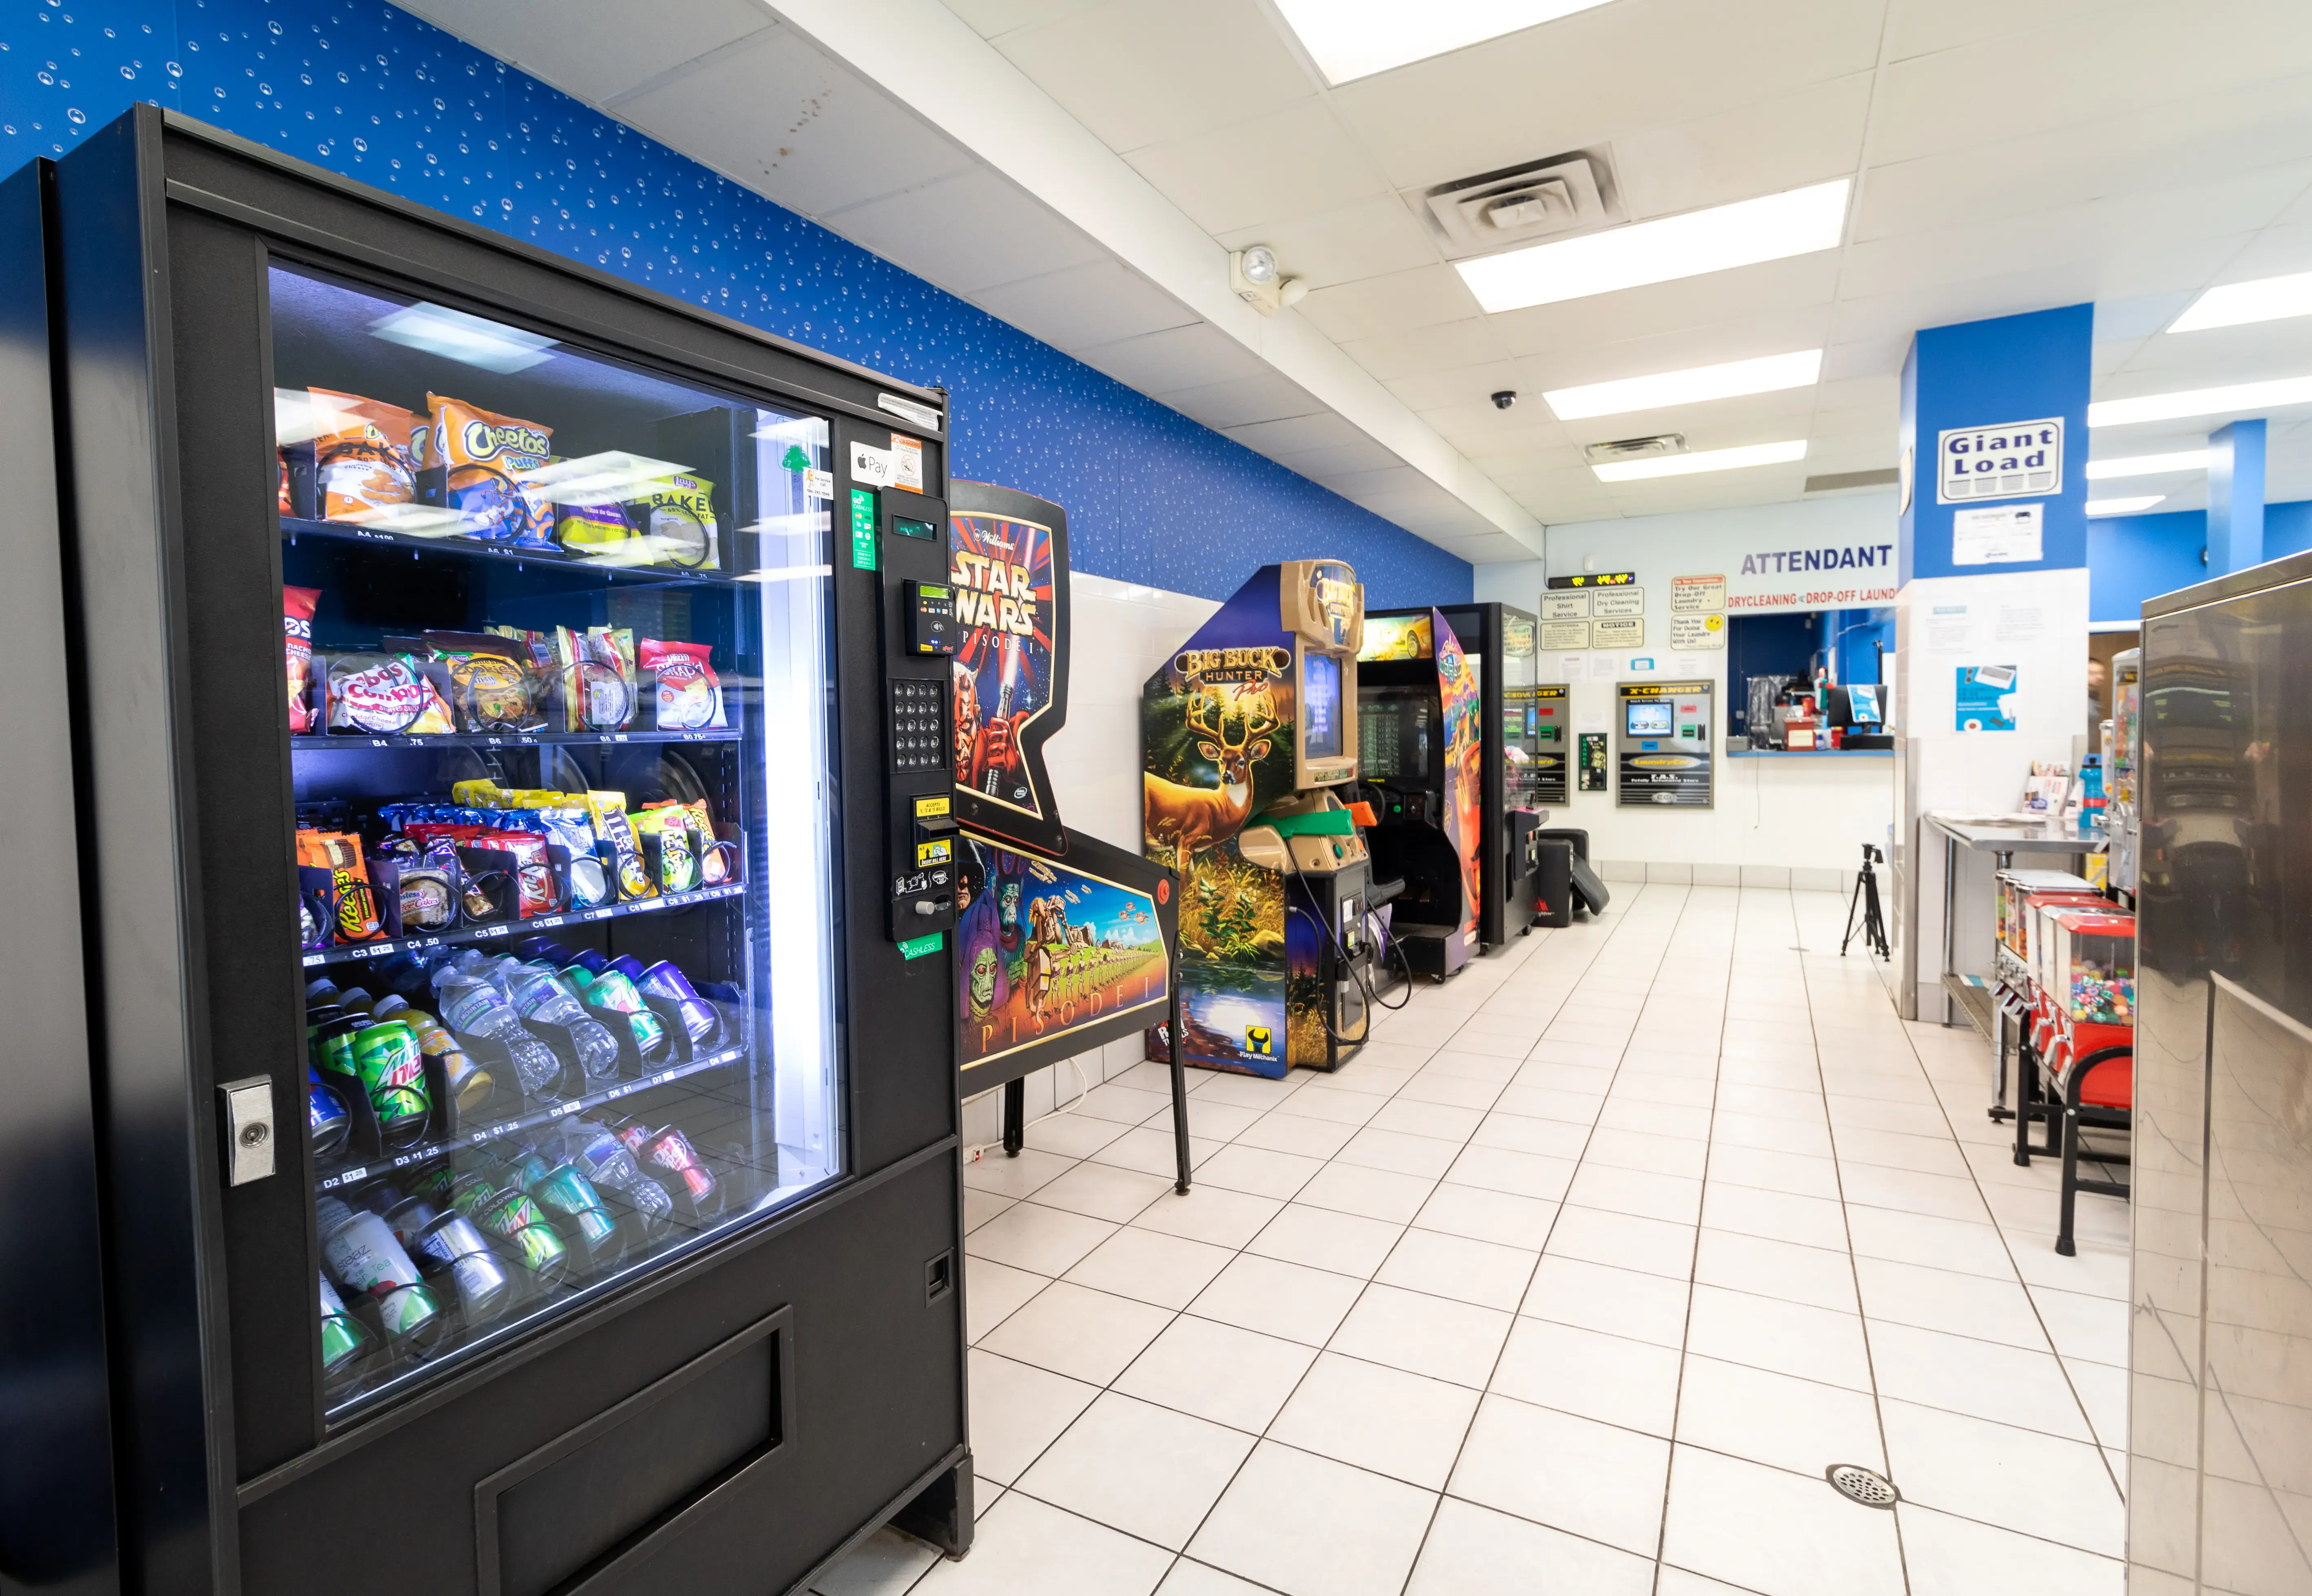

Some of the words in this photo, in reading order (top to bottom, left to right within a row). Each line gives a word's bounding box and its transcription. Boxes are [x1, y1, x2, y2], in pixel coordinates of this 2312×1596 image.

[466, 422, 547, 457] Cheetos
[1949, 429, 2053, 454] Giant
[502, 455, 540, 470] Puffs
[869, 456, 887, 478] Pay
[1954, 450, 2044, 475] Load
[675, 476, 696, 489] Lay's
[853, 497, 862, 505] GO
[982, 530, 1015, 551] Williams
[1741, 545, 1892, 575] ATTENDANT
[951, 550, 1037, 602] STAR
[1544, 593, 1586, 601] Professional
[1728, 594, 1797, 608] DRYCLEANING
[1806, 590, 1856, 604] DROP-OFF
[1860, 588, 1897, 601] LAUND
[956, 588, 1036, 636] WARS
[963, 631, 1021, 652] PISODE
[1029, 642, 1033, 654] I
[1186, 650, 1221, 680] BIG
[1223, 647, 1281, 677] BUCK
[1206, 670, 1262, 681] HUNTER
[1232, 679, 1269, 701] Pro
[1630, 686, 1701, 694] X-CHANGER
[372, 715, 396, 725] Cheese
[415, 897, 439, 907] Cakes
[475, 930, 489, 938] C5
[407, 941, 421, 949] C4
[425, 938, 440, 947] .50
[904, 942, 936, 958] CASHLESS
[307, 956, 321, 964] .75
[352, 949, 368, 958] C3
[461, 999, 489, 1021] MOUNTAIN
[981, 984, 1124, 1053] PISODE
[1144, 977, 1149, 999] I
[1239, 1051, 1252, 1060] Play
[1253, 1053, 1277, 1062] Mechanix
[653, 1076, 662, 1084] D7
[609, 1090, 620, 1098] D6
[623, 1085, 632, 1093] $1
[551, 1109, 563, 1117] D5
[473, 1132, 487, 1141] D4
[493, 1125, 504, 1134] $1
[506, 1122, 519, 1132] .25
[396, 1156, 409, 1166] D3
[413, 1151, 423, 1160] $1
[425, 1146, 439, 1157] .25
[653, 1145, 669, 1166] Dr
[324, 1178, 339, 1189] D2
[484, 1198, 503, 1216] COLD
[502, 1190, 520, 1200] WAR
[337, 1245, 371, 1271] steaz
[370, 1258, 391, 1272] Tea
